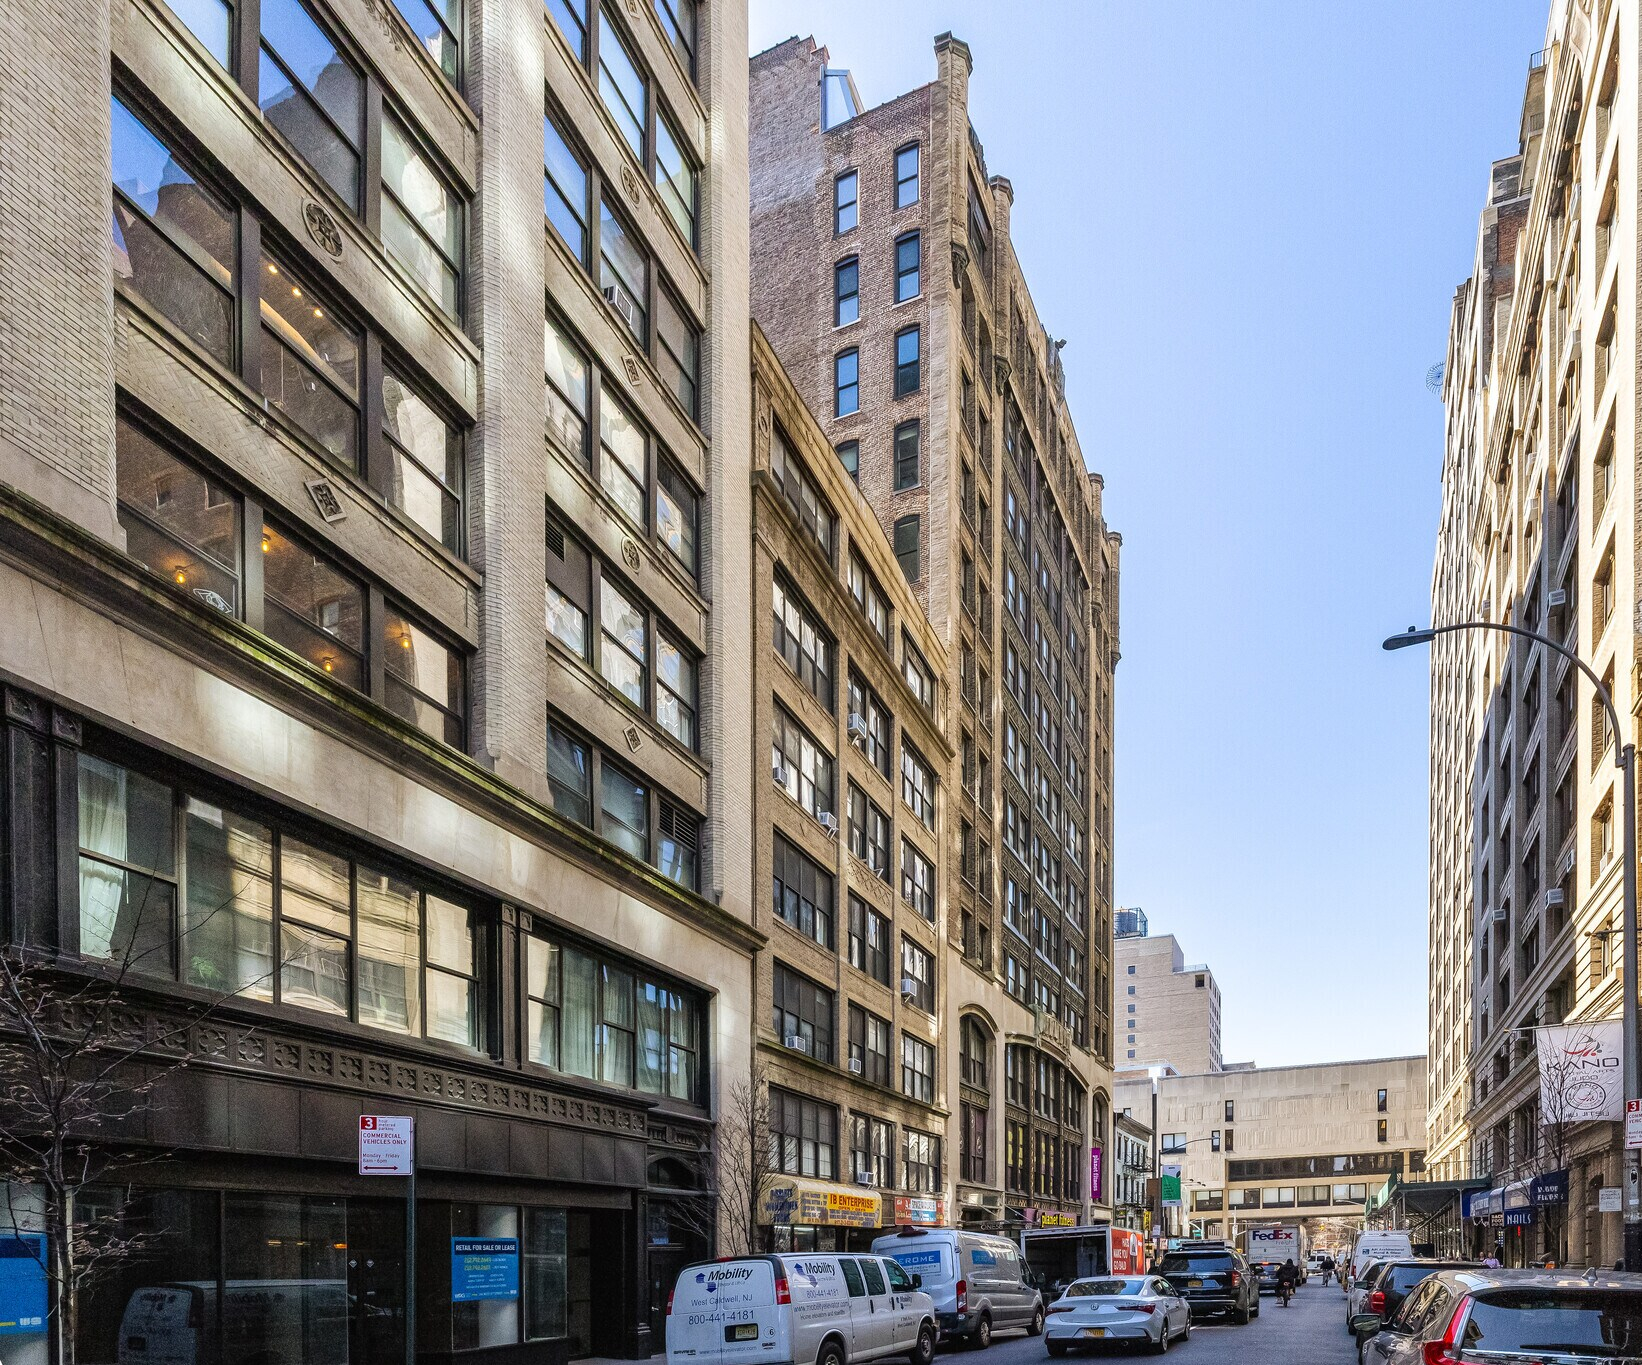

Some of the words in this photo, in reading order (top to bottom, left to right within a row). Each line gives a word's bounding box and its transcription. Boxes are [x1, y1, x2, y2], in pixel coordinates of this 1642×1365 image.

[1547, 1057, 1619, 1072] KANO
[1630, 1101, 1637, 1112] 3
[365, 1118, 374, 1129] 3
[830, 1194, 838, 1205] IB
[838, 1194, 874, 1209] ENTERPRISE
[1041, 1214, 1059, 1228] planet
[1059, 1213, 1075, 1227] fitness
[1507, 1213, 1531, 1225] NAILS
[1252, 1229, 1293, 1241] FedEx
[897, 1255, 935, 1265] EROME
[707, 1267, 754, 1282] Mobility
[804, 1262, 836, 1277] Mobility
[807, 1288, 840, 1299] 800-441-4181
[691, 1299, 709, 1308] West
[709, 1295, 741, 1305] Caldwell,
[742, 1293, 753, 1302] NJ
[688, 1309, 754, 1326] 800-441-4181
[769, 1328, 775, 1336] 6
